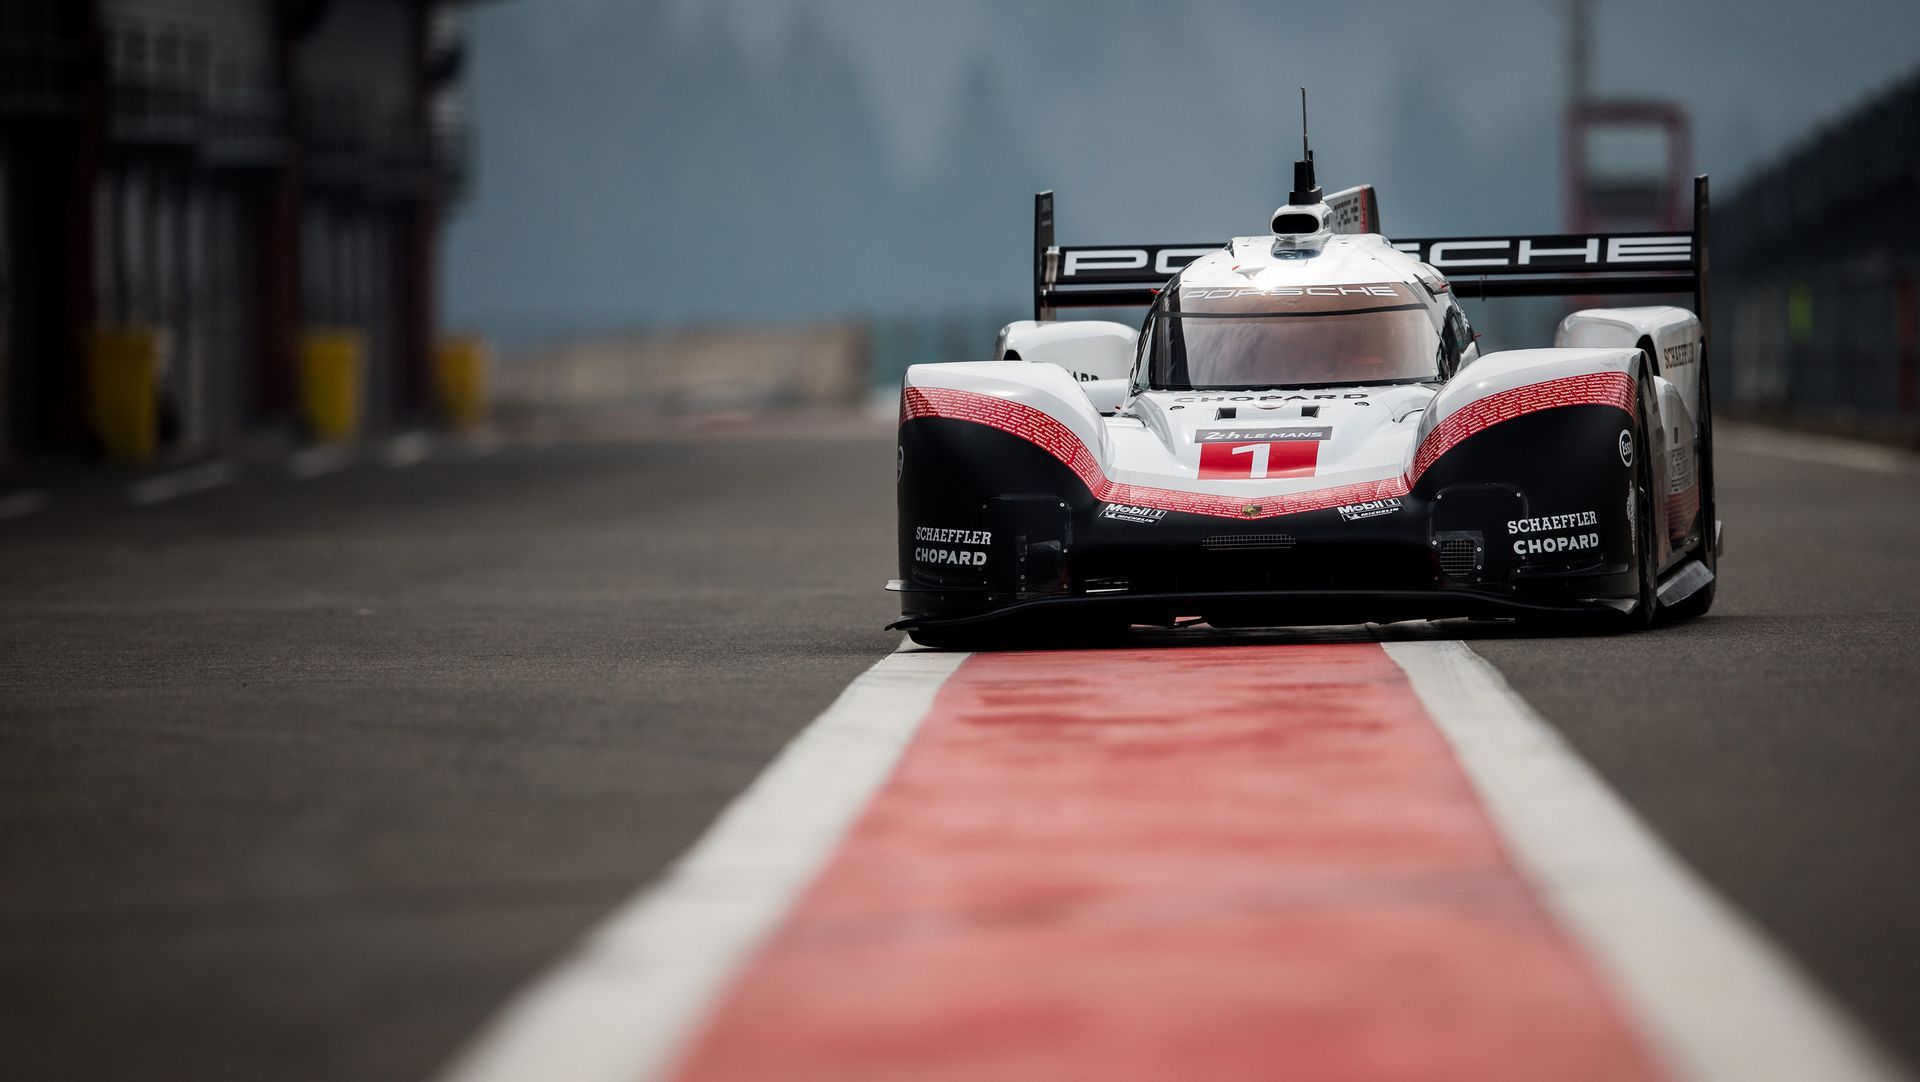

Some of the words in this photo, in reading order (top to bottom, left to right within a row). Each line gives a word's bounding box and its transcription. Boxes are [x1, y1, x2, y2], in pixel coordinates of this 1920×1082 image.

[1183, 286, 1399, 299] PORSCHE
[1174, 394, 1369, 402] CHOPARD
[1231, 443, 1271, 479] 1
[1105, 503, 1151, 516] Mobil
[1337, 500, 1384, 514] Mobil
[1507, 511, 1597, 534] SCHAEFFLER
[915, 526, 992, 545] SCHAEFFLER
[1513, 533, 1599, 555] CHOPARD
[915, 547, 987, 566] CHOPARD
